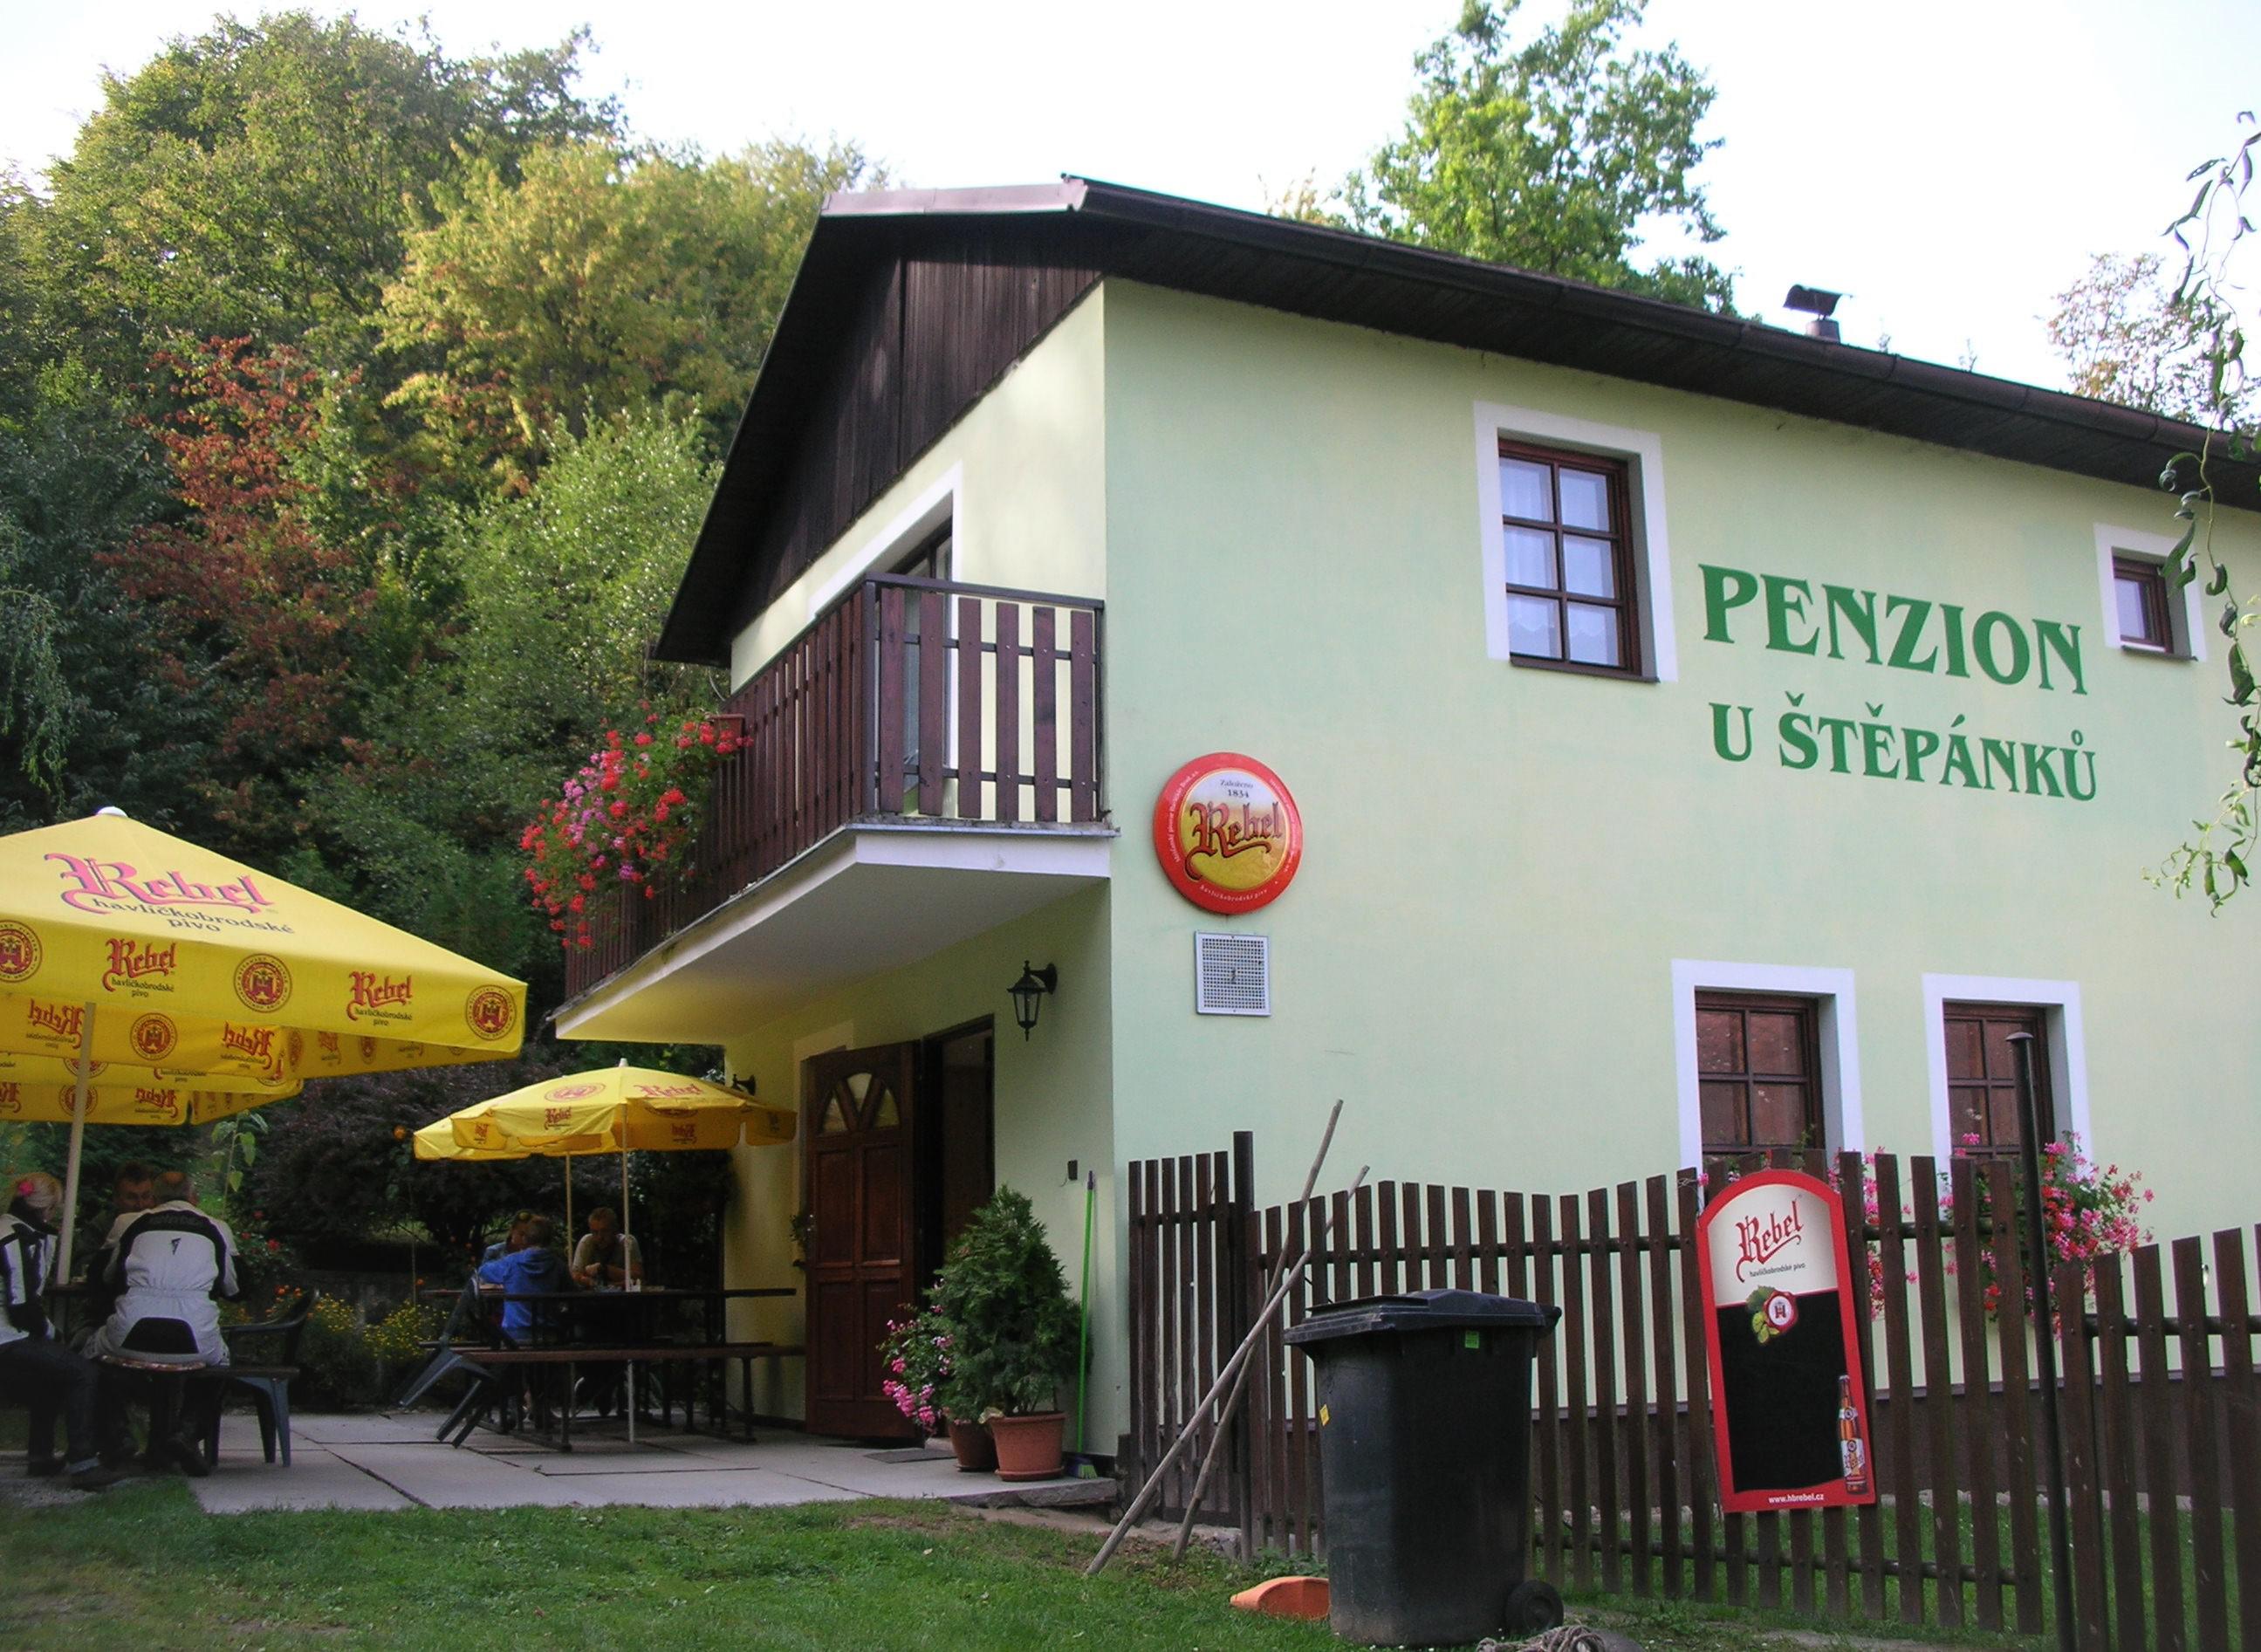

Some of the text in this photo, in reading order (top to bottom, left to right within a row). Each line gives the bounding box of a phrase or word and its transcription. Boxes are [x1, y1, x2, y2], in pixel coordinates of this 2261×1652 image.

[1697, 562, 2088, 696] PENZION
[1708, 689, 2097, 802] U ŠTĚPÁNKŮ
[1227, 789, 1250, 799] 1834
[1185, 800, 1284, 881] Rebel
[44, 853, 274, 915] Rebel
[168, 917, 221, 932] pivo
[102, 938, 177, 993] Rebel
[131, 990, 149, 998] pivo
[346, 970, 414, 1022] Rebel
[1735, 1198, 1805, 1284] Rebel
[1767, 1492, 1825, 1505] www.hbrebel.cz
